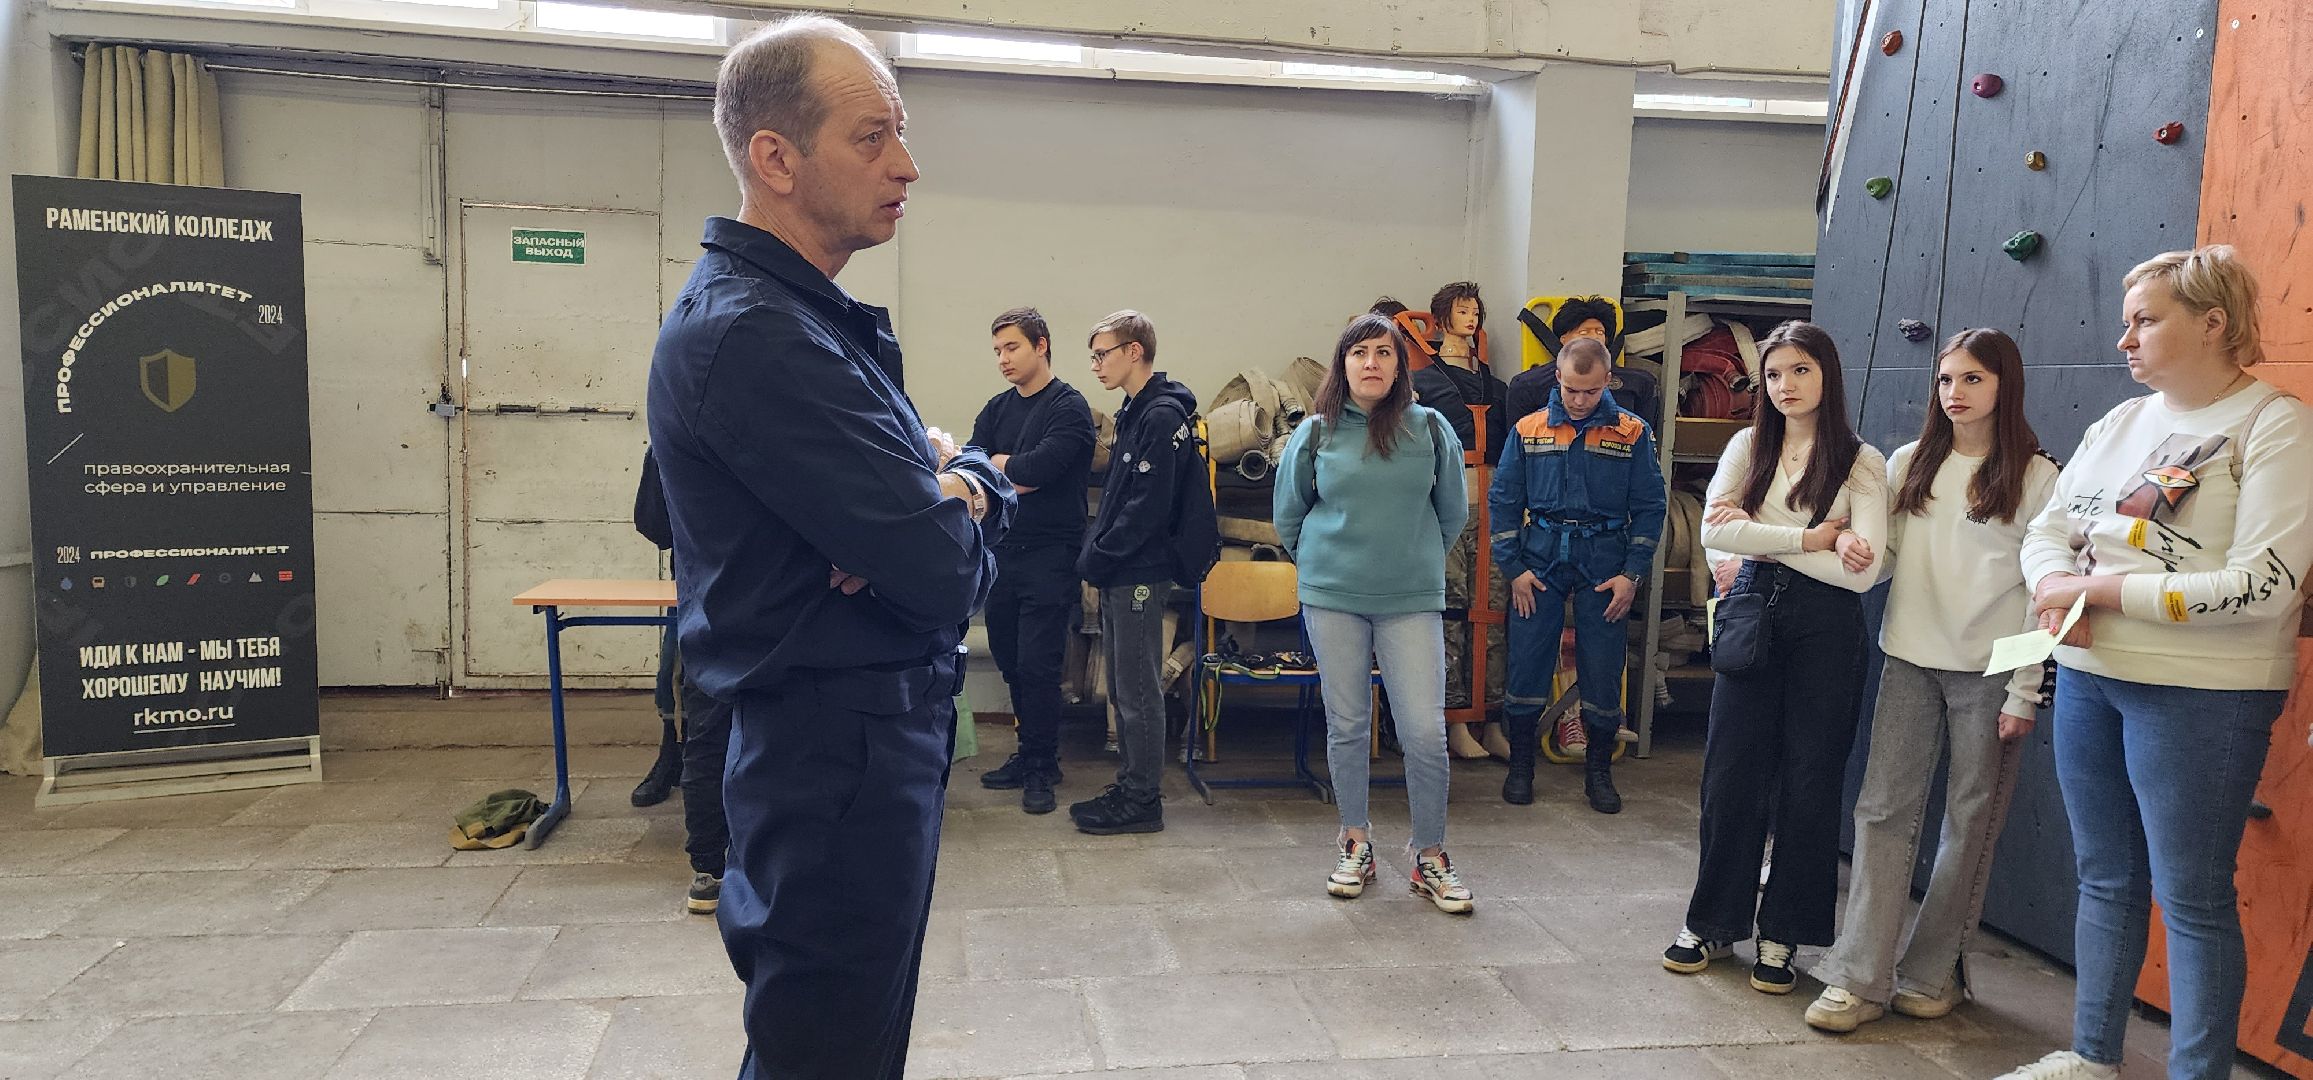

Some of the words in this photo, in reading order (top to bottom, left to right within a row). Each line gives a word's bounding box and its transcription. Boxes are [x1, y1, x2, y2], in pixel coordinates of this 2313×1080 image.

[46, 207, 170, 236] РАМЕНСКИЙ
[174, 214, 273, 242] КОЛЛЕДЖ
[513, 236, 585, 248] ЗАПАСНЫЙ
[525, 247, 574, 258] ВЫХОД
[258, 305, 283, 325] 2024
[56, 281, 253, 414] ПРОФЕССИОНАЛИТЕТ
[84, 463, 290, 477] правоохранительная
[84, 480, 147, 496] сфера
[152, 482, 164, 493] и
[169, 481, 287, 495] управление
[57, 546, 81, 563] 2024
[90, 545, 290, 559] ПРОФЕССИОНАЛИТЕТ
[2187, 547, 2296, 615] Inspire
[79, 645, 122, 669] ИДИ
[125, 643, 139, 665] К
[142, 641, 184, 664] НАМ
[199, 639, 233, 661] МЫ
[236, 636, 281, 658] ТЕБЯ
[81, 673, 189, 699] ХОРОШЕМУ
[199, 667, 282, 692] НАУЧИМ!
[133, 706, 234, 727] rkmo.ru
